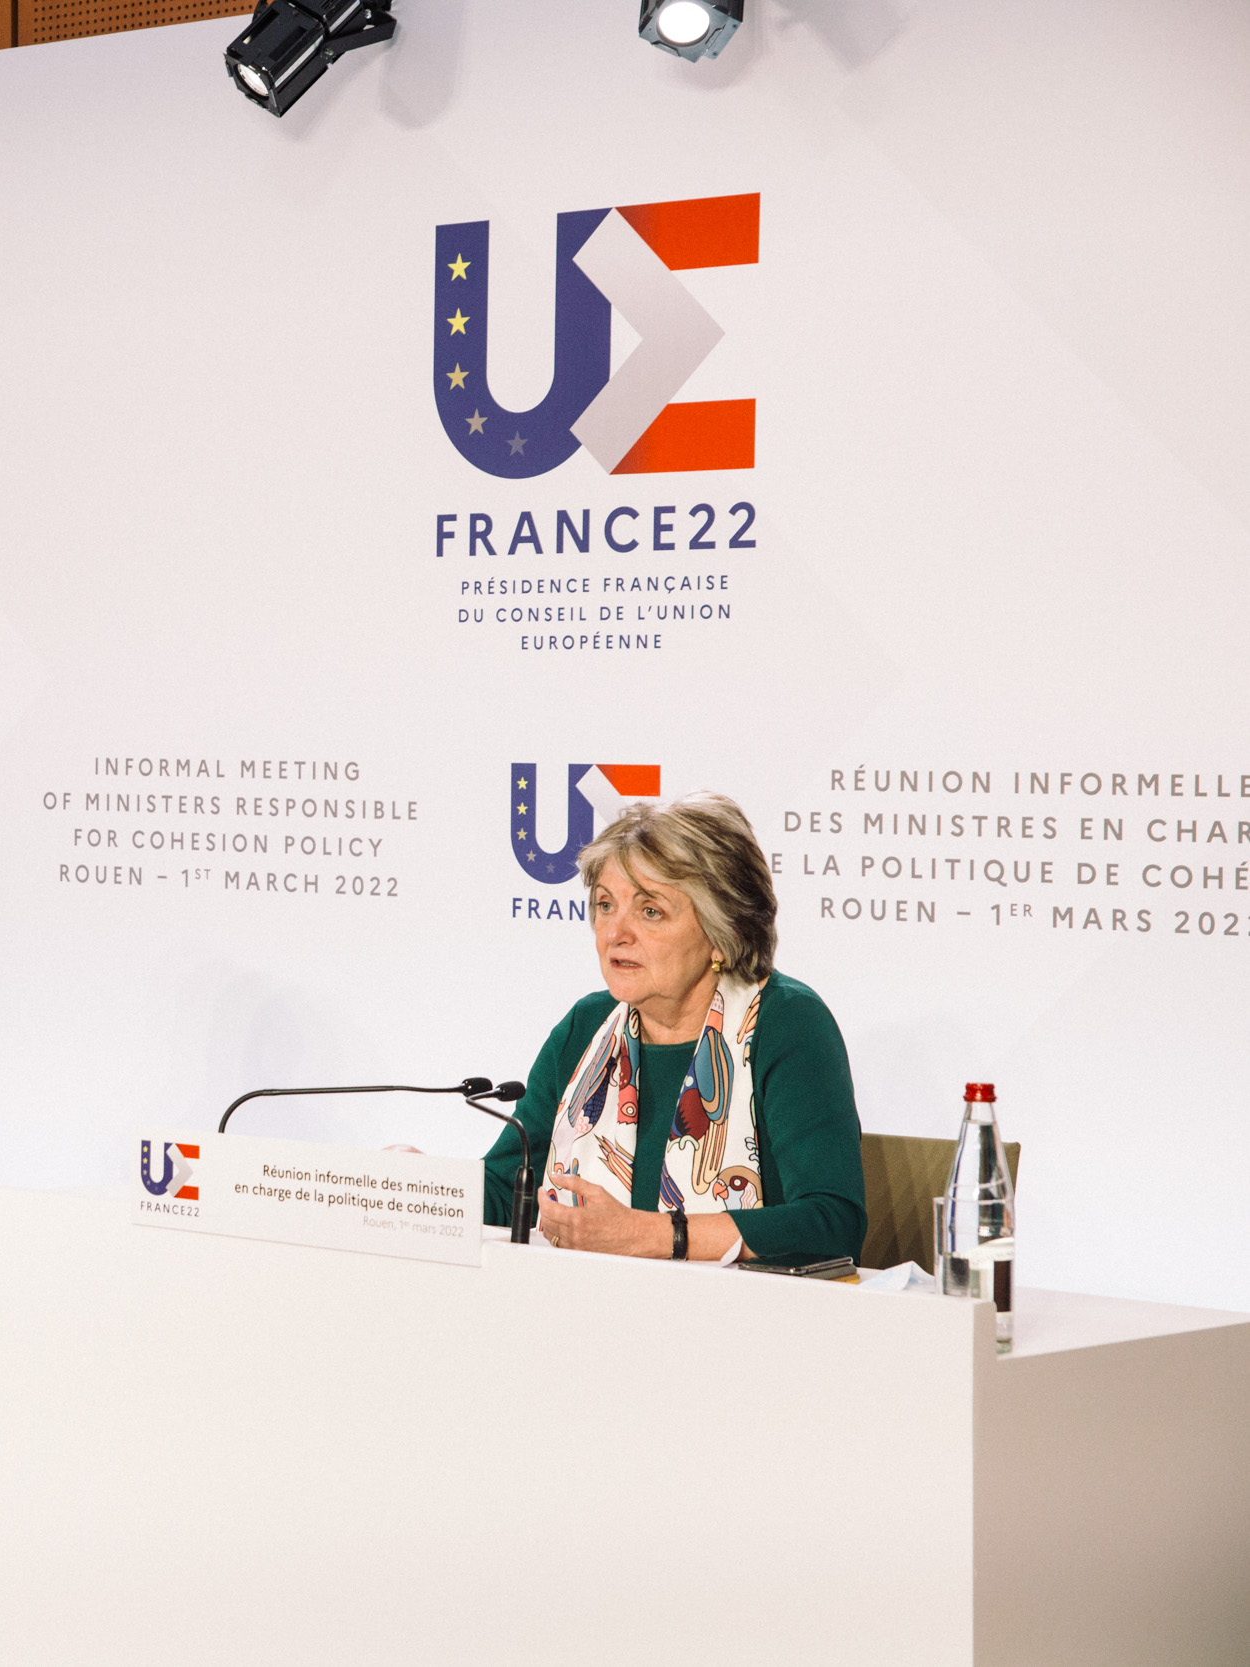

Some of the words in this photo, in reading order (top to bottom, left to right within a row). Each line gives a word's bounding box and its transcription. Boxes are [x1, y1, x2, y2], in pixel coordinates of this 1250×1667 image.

[437, 502, 756, 557] FRANCE22
[462, 578, 589, 594] PRÉSIDENCE
[604, 575, 728, 593] FRANÇAISE
[459, 609, 483, 623] DU
[496, 607, 586, 622] CONSEIL
[600, 606, 623, 621] DE
[522, 631, 661, 650] EUROPÉENNE
[95, 758, 225, 778] INFORMAL
[241, 760, 359, 781] MEETING
[831, 765, 990, 793] RÉUNION
[1015, 772, 1250, 797] INFORMELLE
[43, 792, 71, 810] OF
[86, 793, 220, 815] MINISTERS
[237, 797, 417, 820] RESPONSIBLE
[785, 811, 842, 833] DES
[864, 813, 1056, 839] MINISTRES
[1081, 818, 1122, 840] EN
[74, 829, 117, 847] FOR
[132, 830, 267, 853] COHESION
[285, 836, 382, 857] POLICY
[60, 864, 142, 885] ROUEN
[225, 871, 318, 893] MARCH
[336, 875, 397, 897] 2022
[804, 854, 840, 876] LA
[862, 856, 1053, 887] POLITIQUE
[1077, 863, 1119, 885] DE
[821, 897, 935, 923] ROUEN
[1053, 907, 1151, 932] MARS
[1175, 911, 1250, 936] 202
[262, 1164, 311, 1181] Réunion
[315, 1169, 378, 1189] informelle
[381, 1176, 403, 1192] des
[407, 1179, 464, 1198] ministres
[140, 1201, 200, 1217] FRANCE22
[234, 1183, 249, 1194] en
[252, 1182, 292, 1202] charge
[295, 1187, 311, 1201] de
[314, 1188, 325, 1202] la
[328, 1191, 384, 1211] politique
[387, 1197, 404, 1211] de
[407, 1199, 464, 1219] cohésion
[363, 1216, 397, 1231] Rouen,
[412, 1221, 437, 1234] mars
[439, 1223, 464, 1238] 2022
